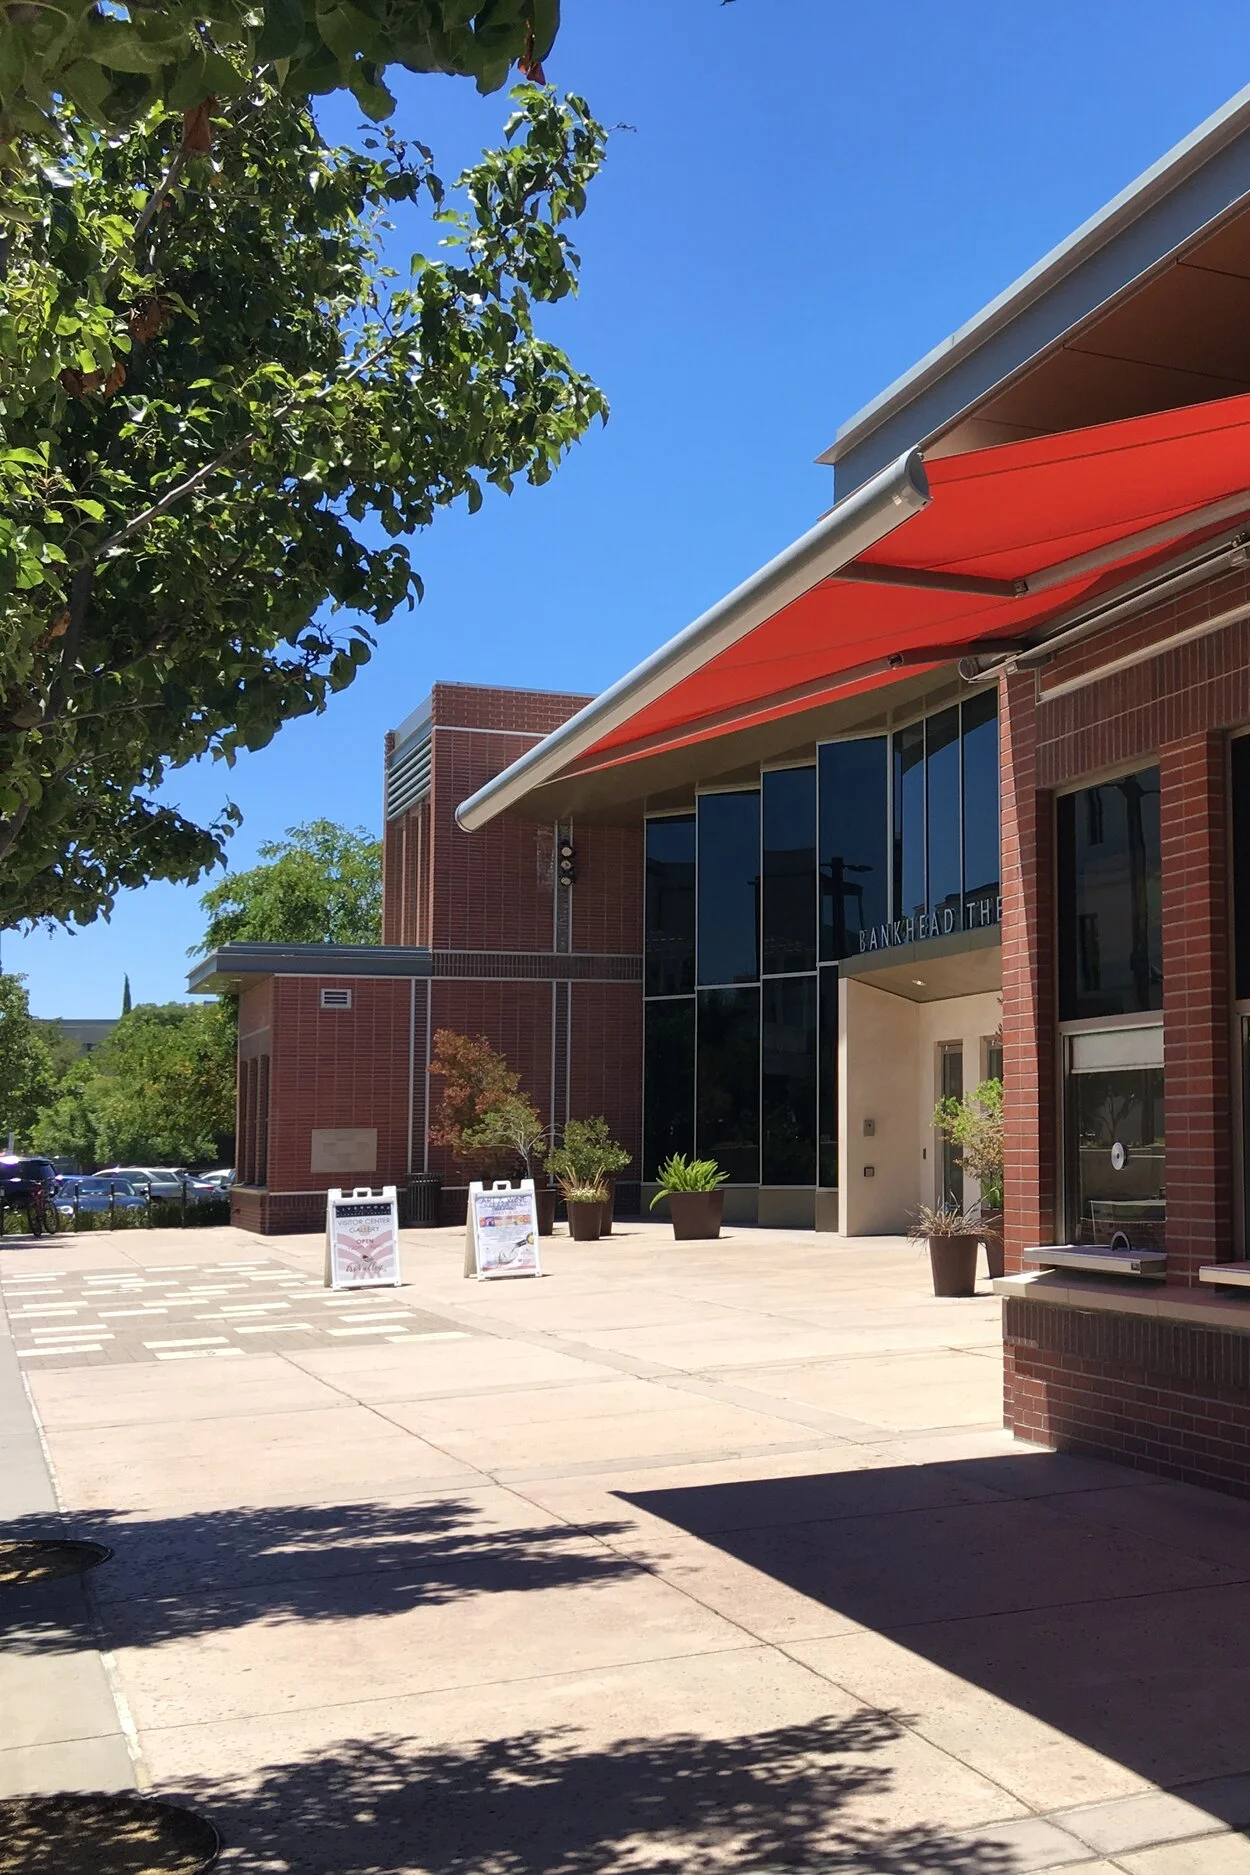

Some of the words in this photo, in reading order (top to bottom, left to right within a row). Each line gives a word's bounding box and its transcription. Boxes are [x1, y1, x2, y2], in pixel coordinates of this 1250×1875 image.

[859, 908, 955, 953] BANKHEAD
[337, 1217, 363, 1226] VISITOR
[364, 1217, 391, 1225] CENTER
